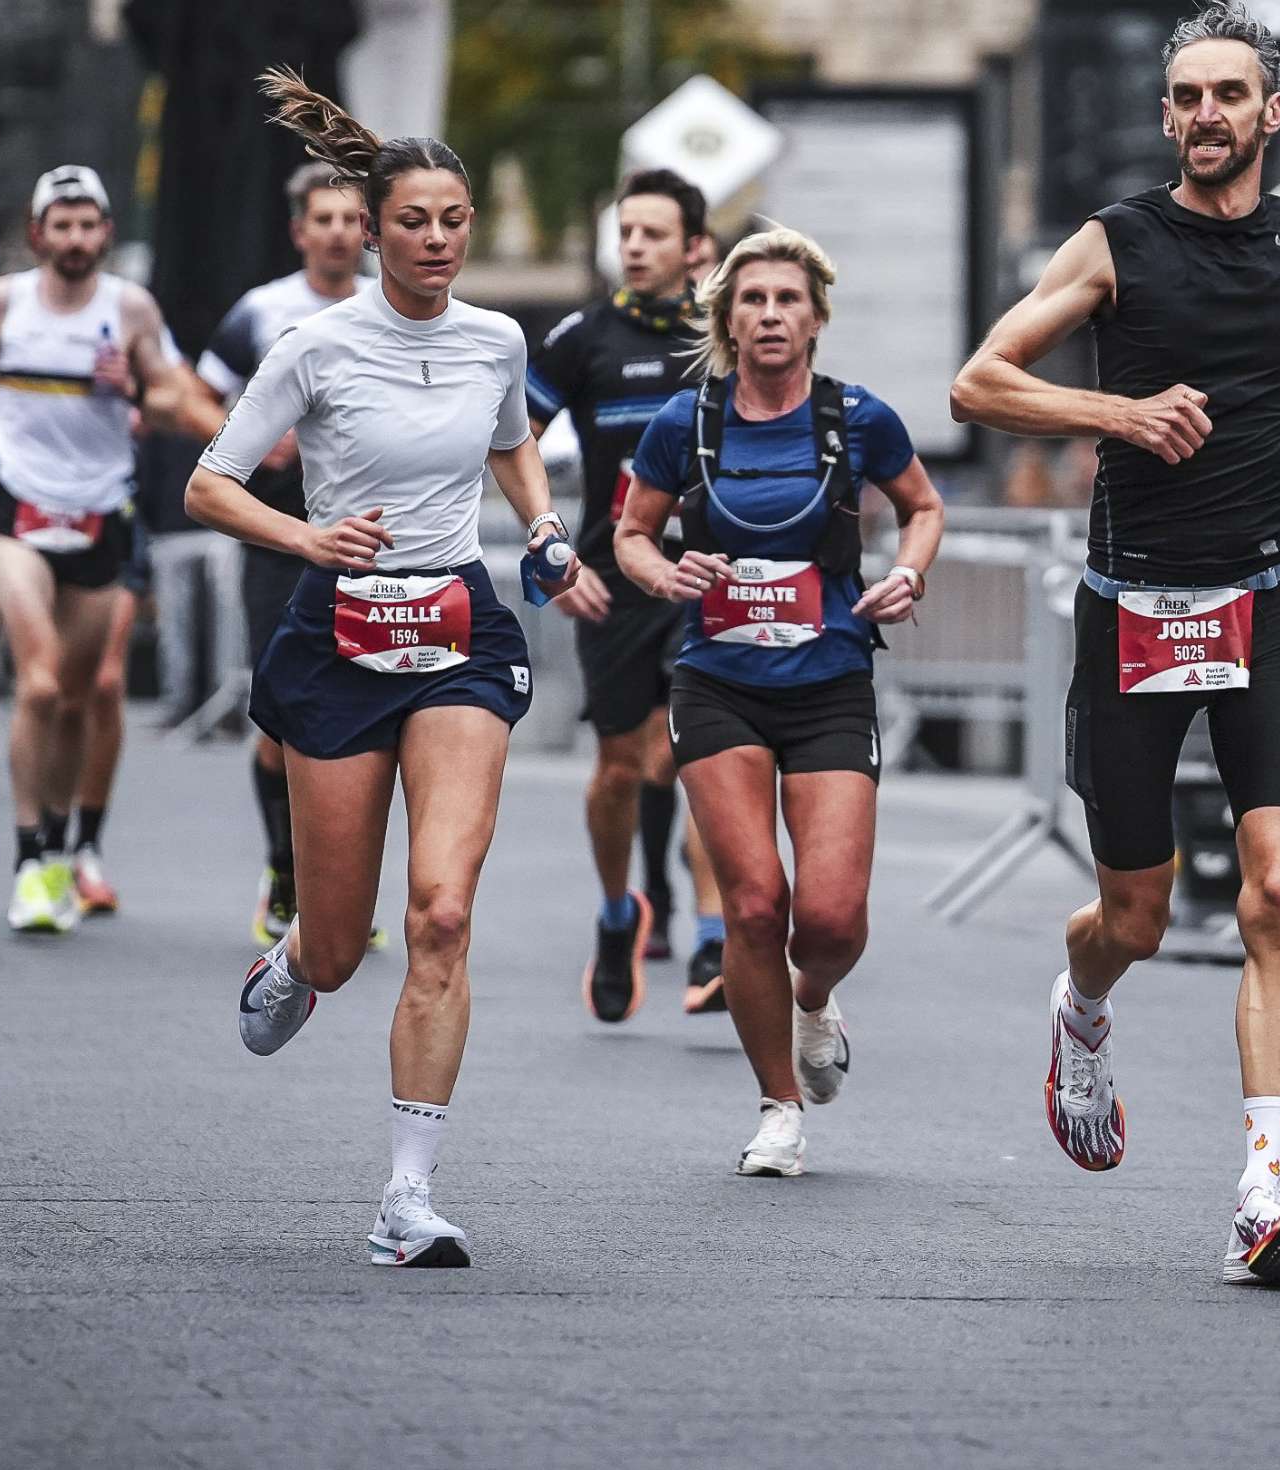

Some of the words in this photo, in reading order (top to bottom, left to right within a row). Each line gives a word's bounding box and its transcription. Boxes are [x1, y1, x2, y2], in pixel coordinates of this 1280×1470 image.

[373, 583, 406, 594] TREK
[727, 585, 797, 602] RENATE
[1157, 599, 1190, 610] TREK
[366, 606, 441, 624] AXELLE
[747, 606, 776, 621] 4285
[390, 629, 419, 645] 1596
[1156, 619, 1222, 640] JORIS
[1174, 644, 1206, 661] 5025
